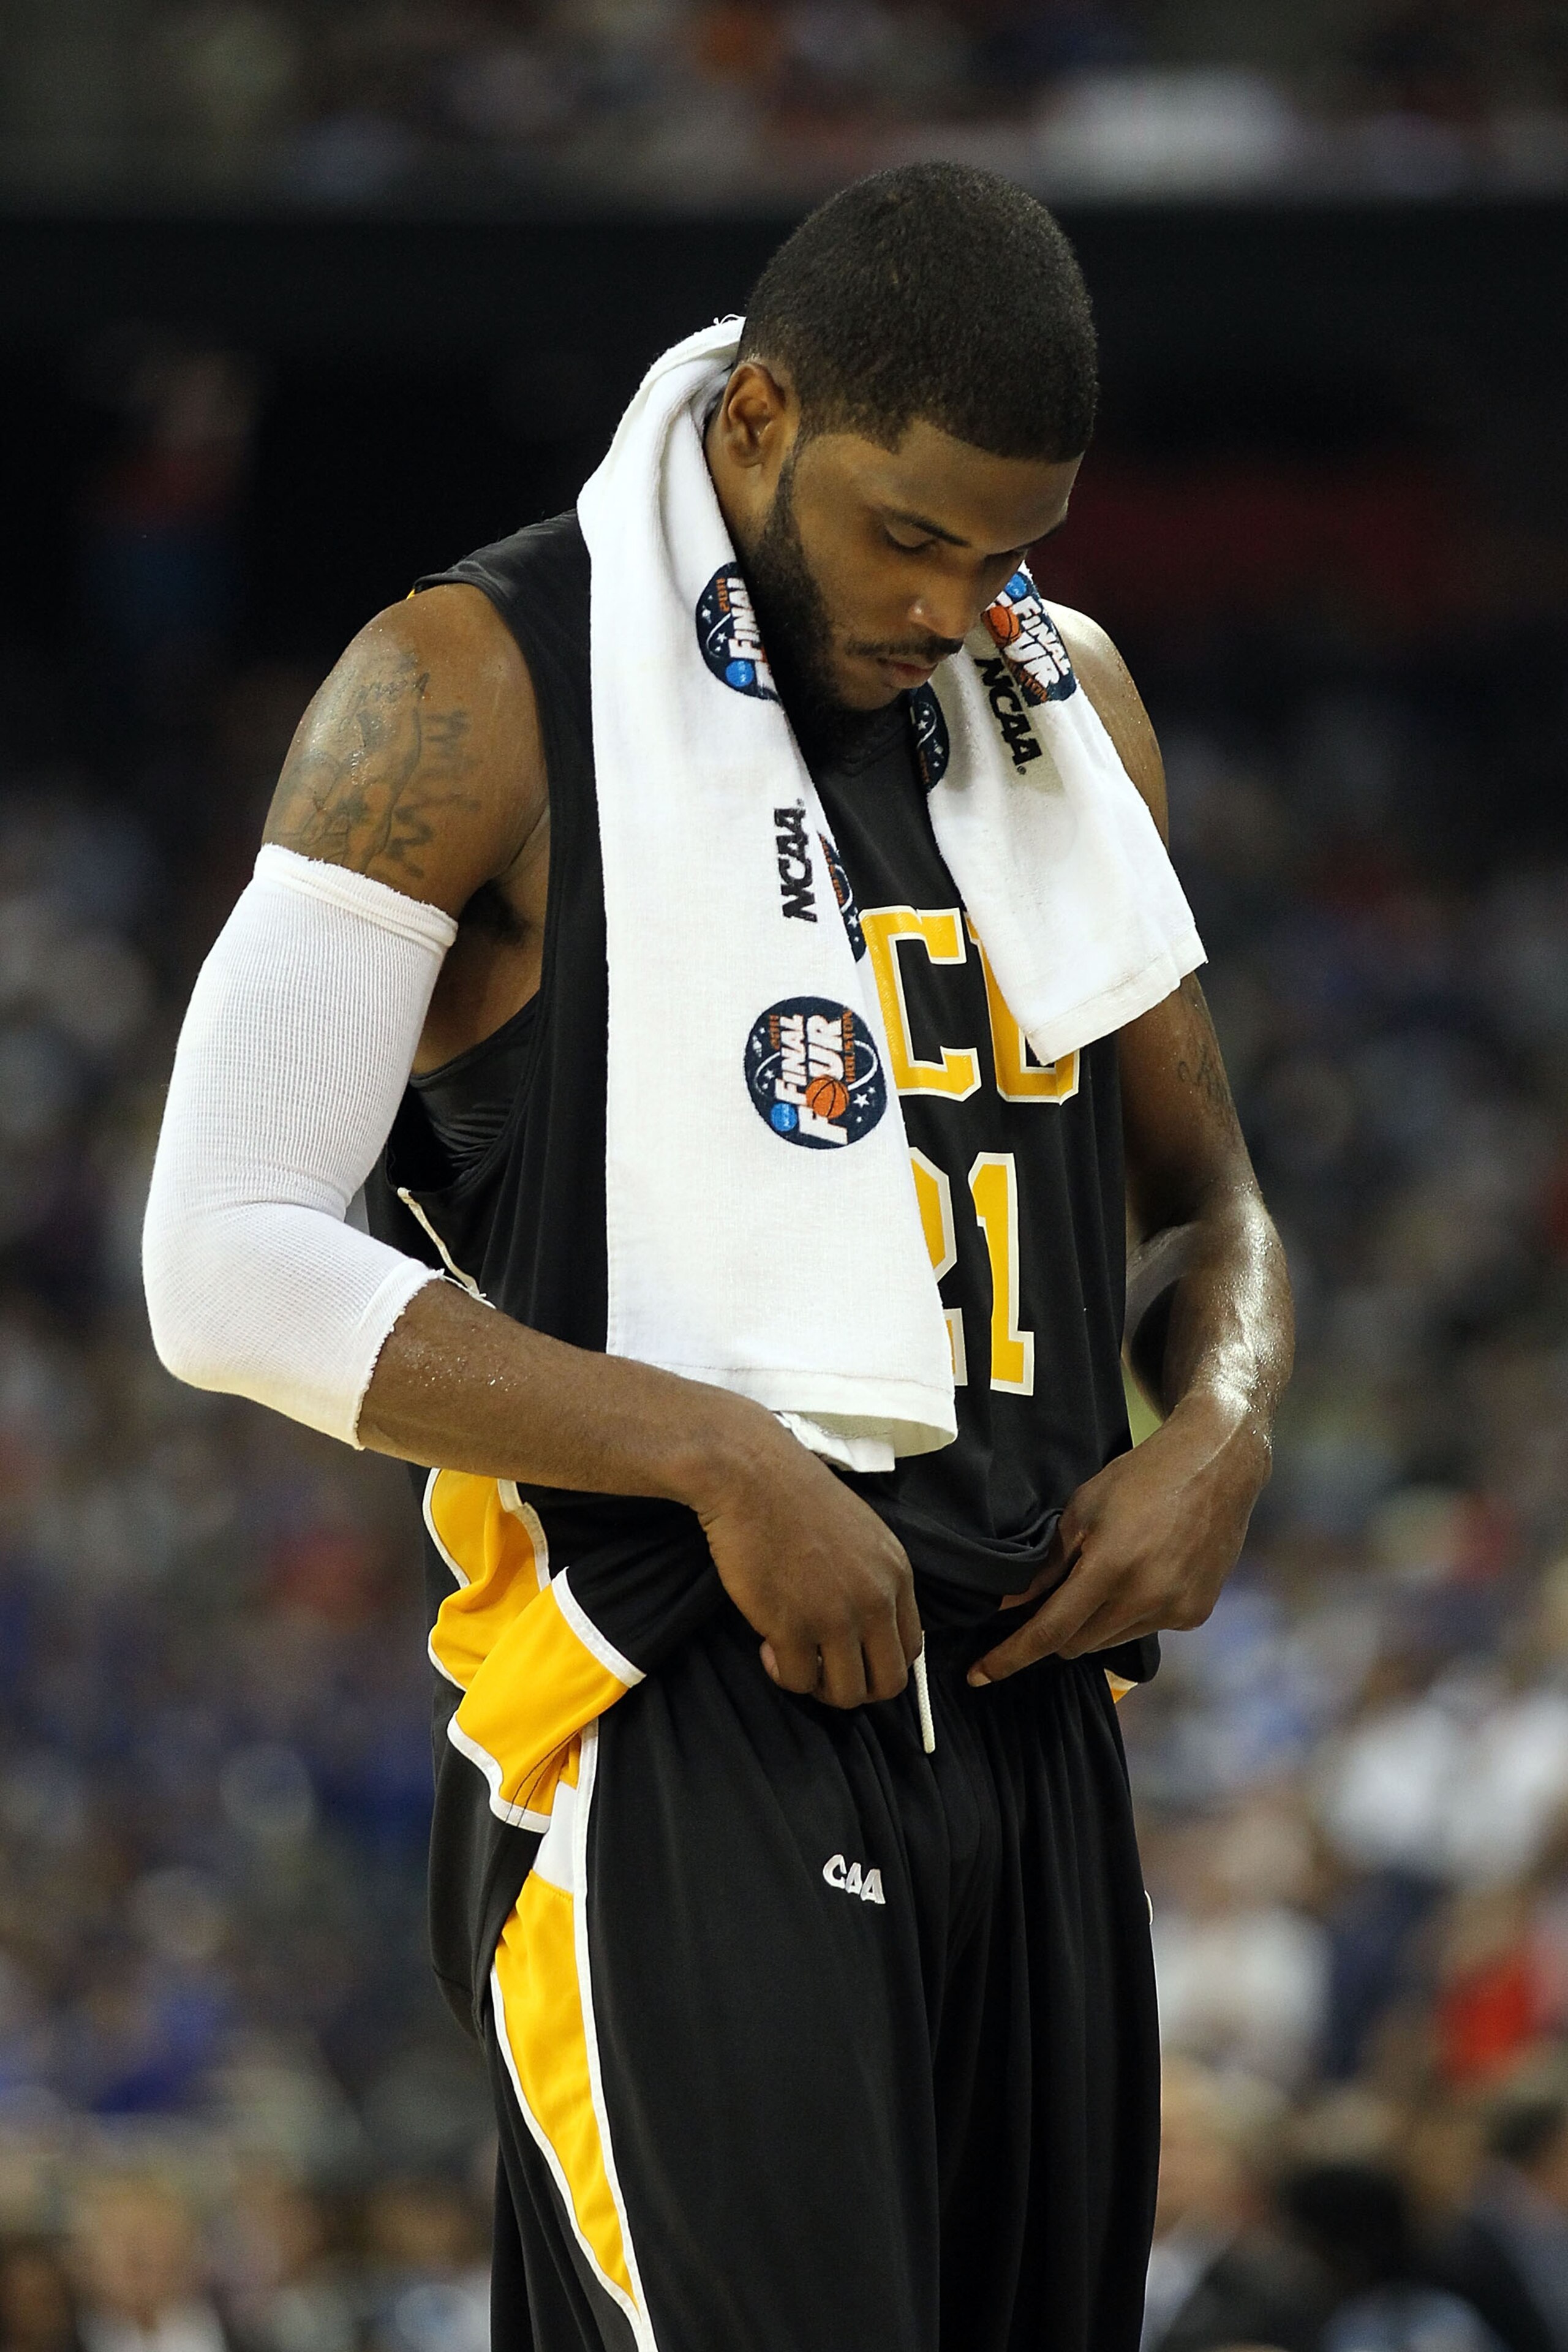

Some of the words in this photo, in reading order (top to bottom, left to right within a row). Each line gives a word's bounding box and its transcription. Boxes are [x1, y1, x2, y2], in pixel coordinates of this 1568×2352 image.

[1011, 595, 1071, 676] FINAL
[974, 657, 1042, 766] NCAA
[774, 808, 818, 923] NCAA
[859, 905, 1080, 1106] CU
[775, 1014, 813, 1107] FINAL
[823, 1854, 886, 1905] CAA
